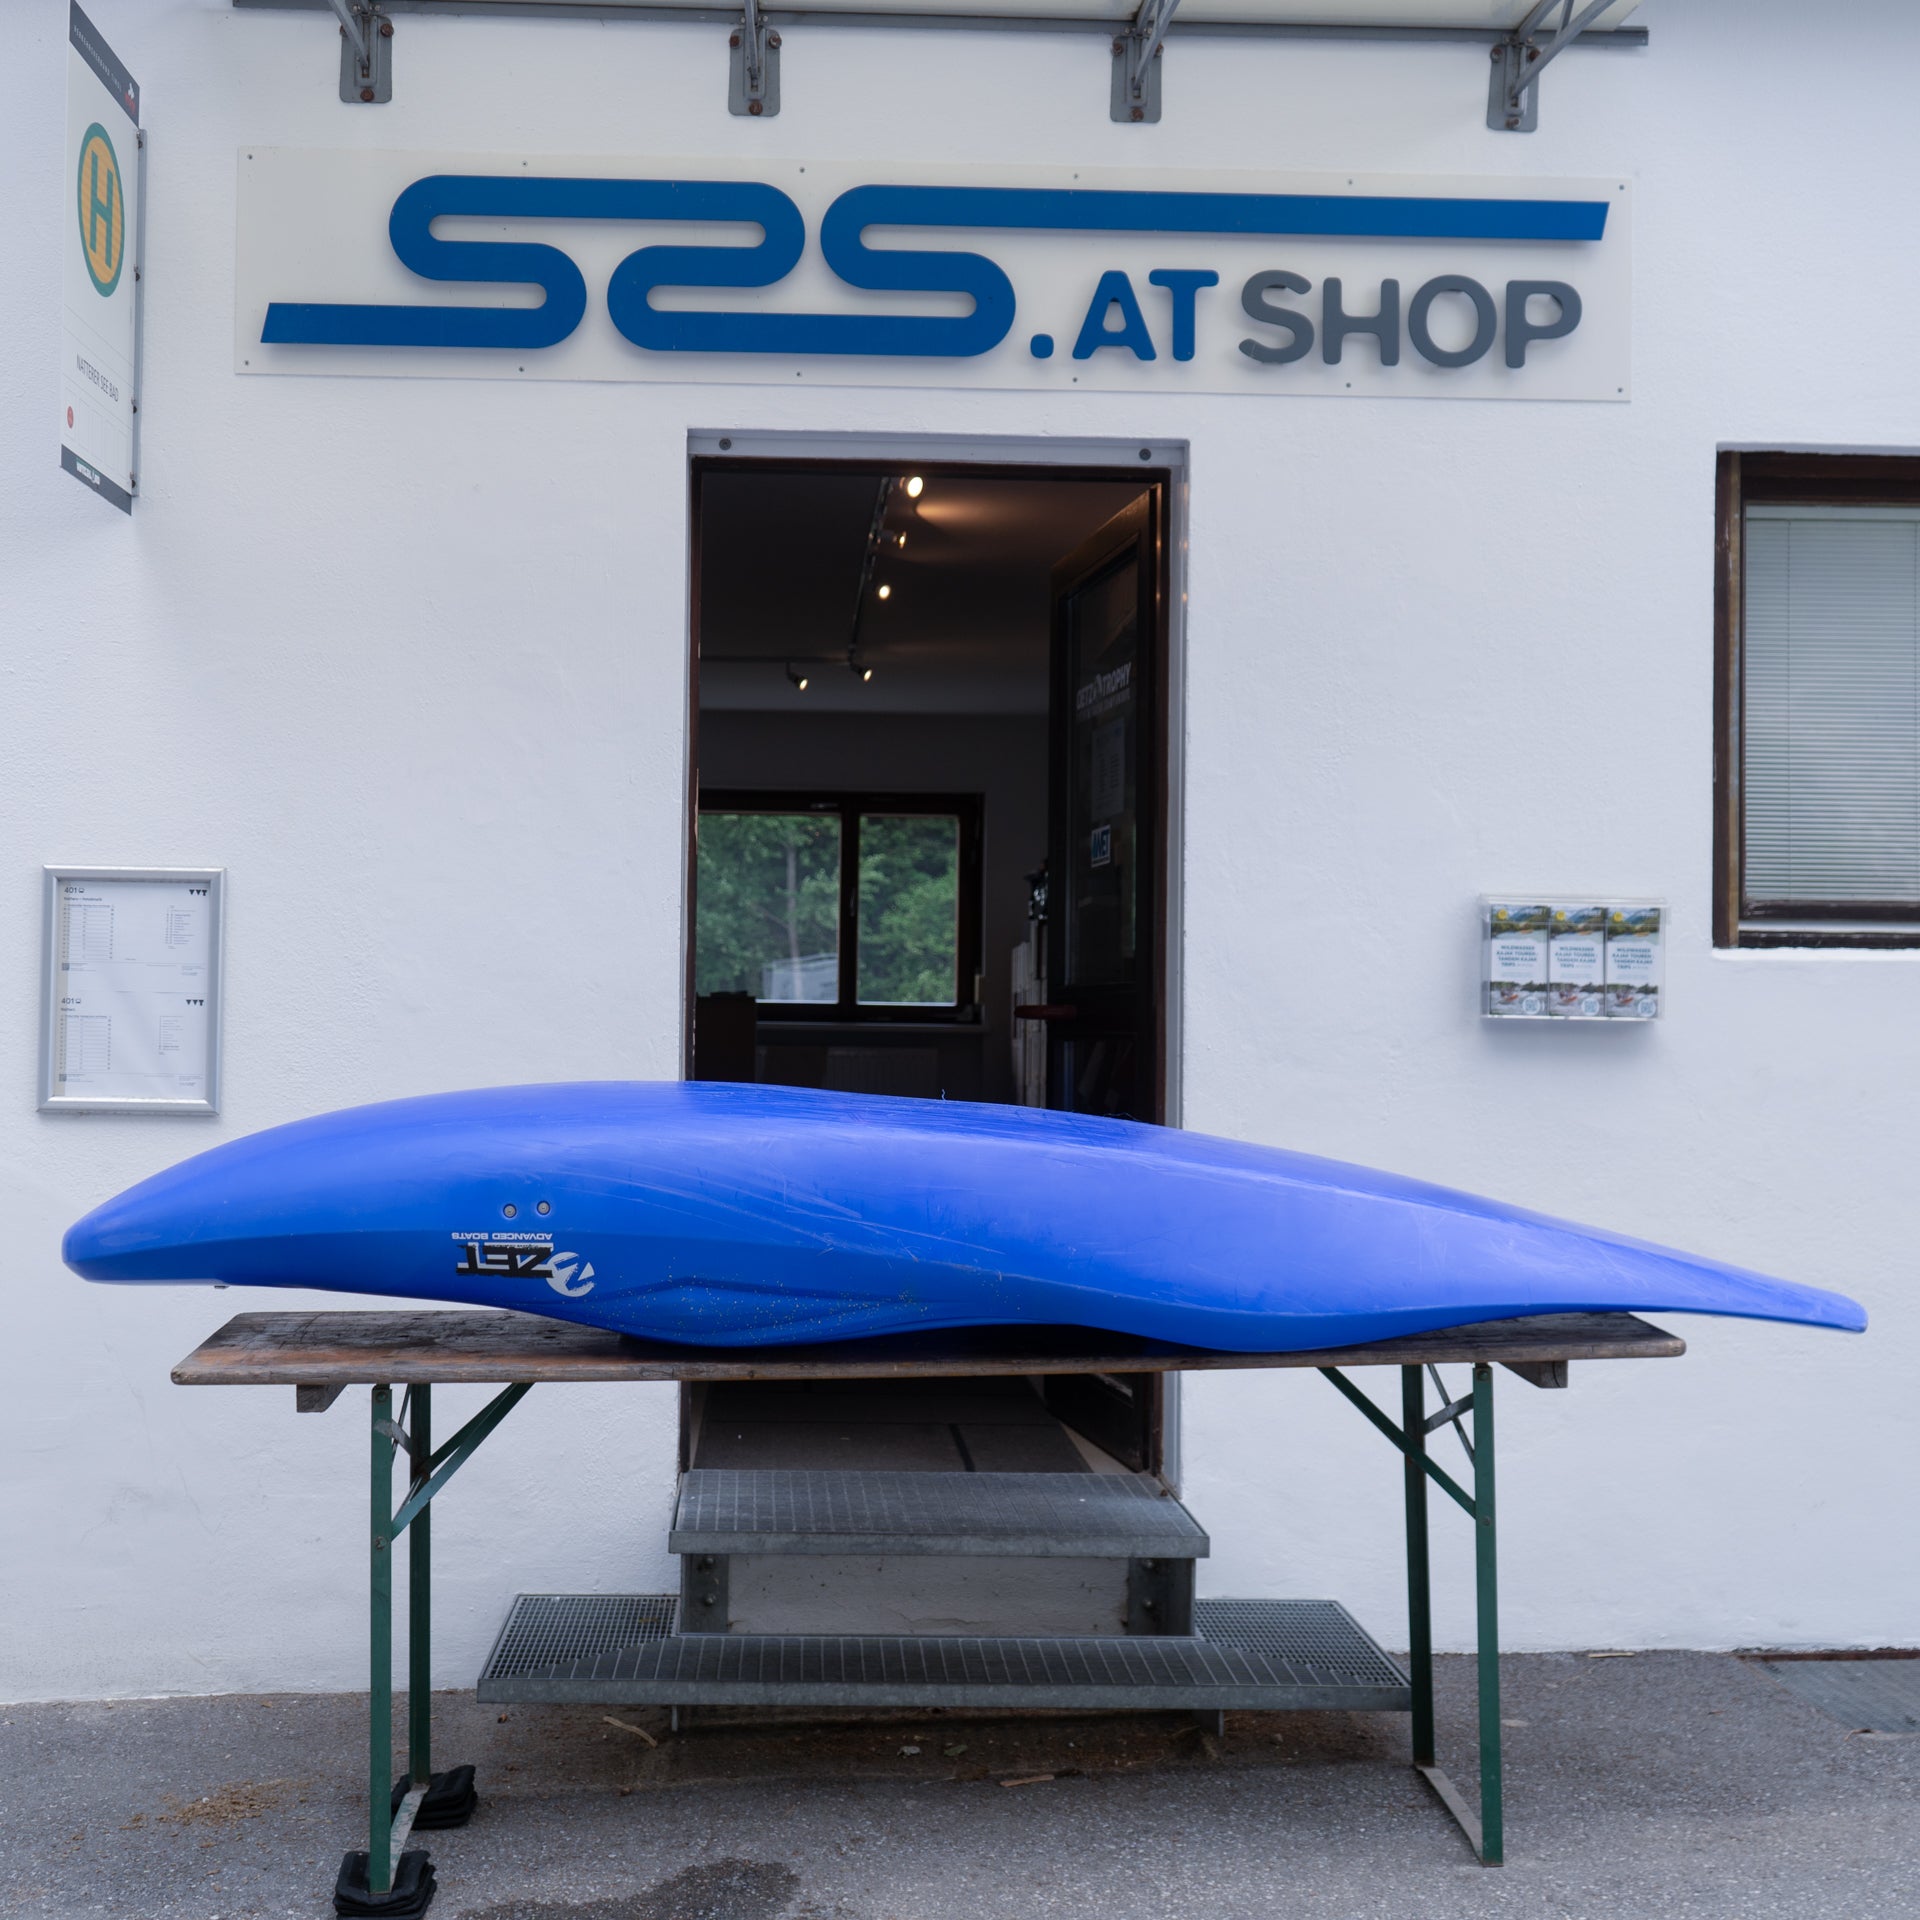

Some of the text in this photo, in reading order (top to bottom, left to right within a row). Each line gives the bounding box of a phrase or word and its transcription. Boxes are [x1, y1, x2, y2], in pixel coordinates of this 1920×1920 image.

[90, 149, 113, 270] H
[1239, 269, 1582, 369] SHOP
[76, 353, 119, 403] NATTERER SEE BAD
[451, 1232, 553, 1240] ADVANCED BOATS
[456, 1242, 554, 1278] ZET
